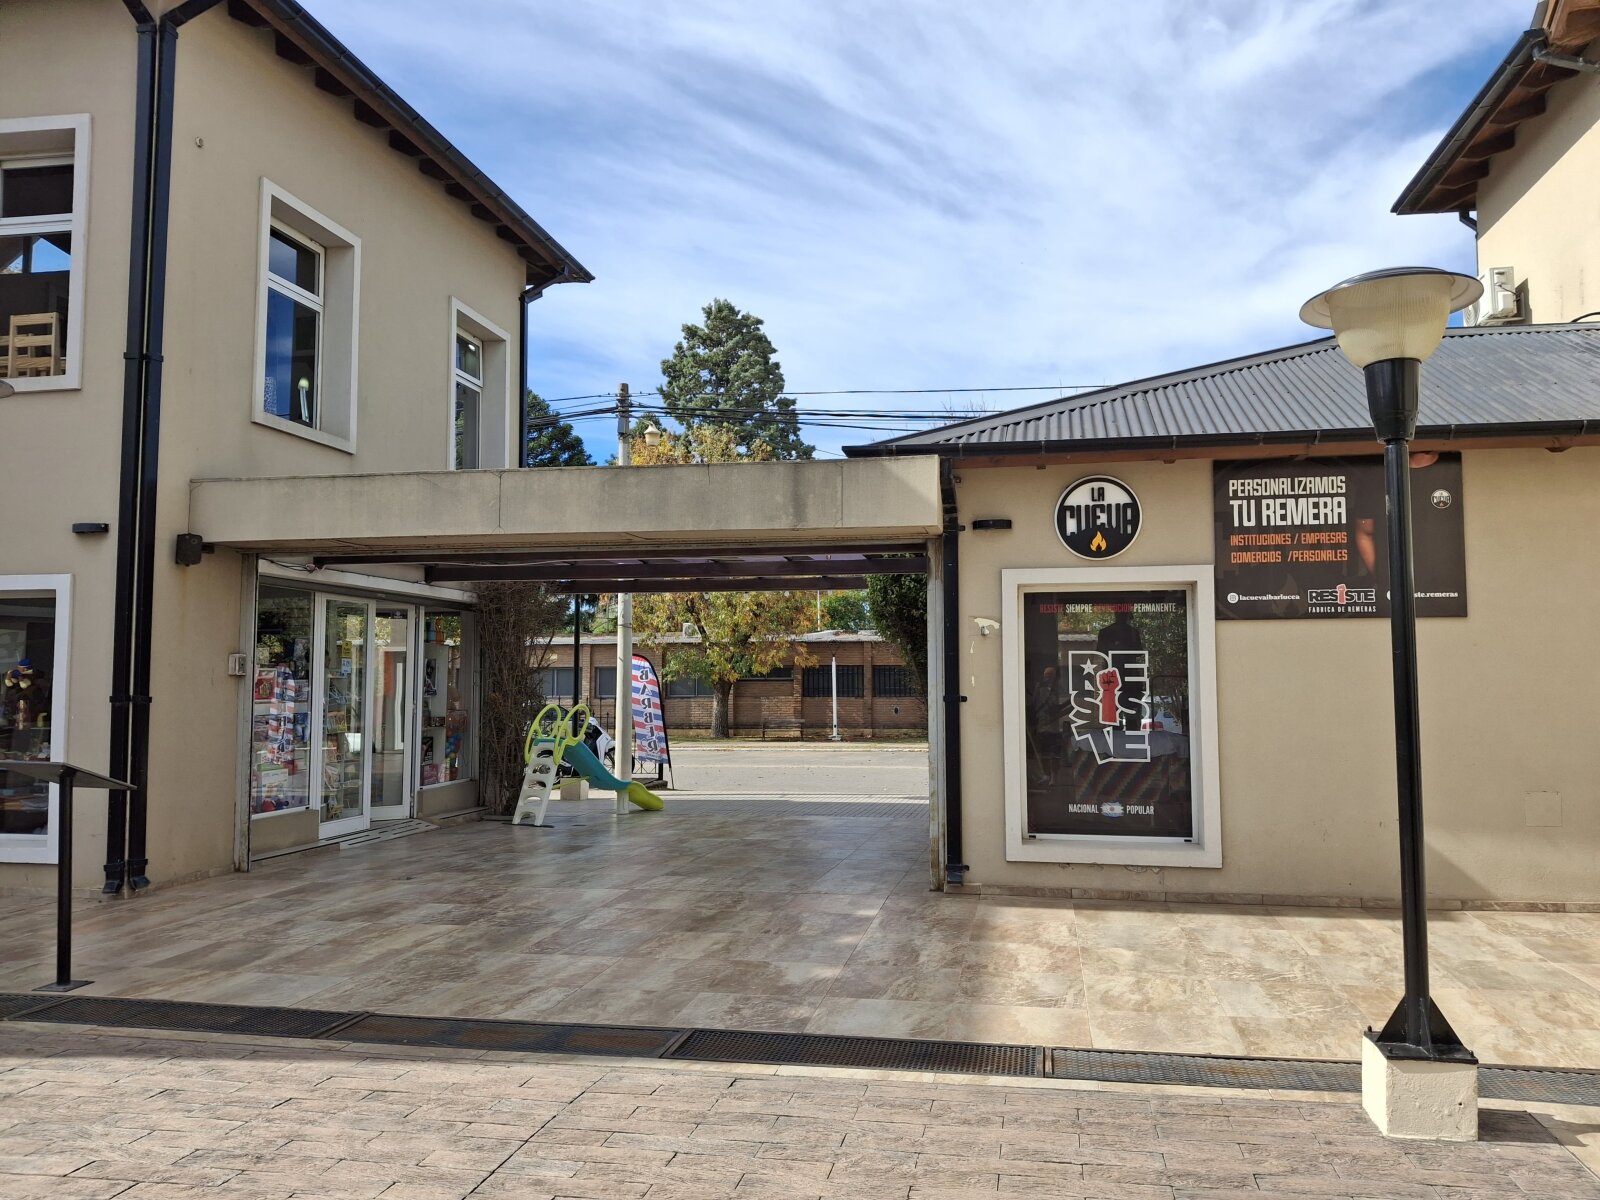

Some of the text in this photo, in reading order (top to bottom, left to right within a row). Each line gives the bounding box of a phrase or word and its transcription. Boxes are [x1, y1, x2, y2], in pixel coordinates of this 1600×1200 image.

[1229, 476, 1346, 497] PERSONALIZAMOS
[1091, 487, 1104, 501] LA
[1230, 496, 1347, 527] TU REMERA
[1063, 502, 1136, 536] CUEVA
[1230, 533, 1291, 546] INSTITUCIONES
[1301, 532, 1347, 544] EMPRESAS
[1231, 551, 1282, 564] COMERCIOS
[1065, 603, 1093, 613] SIEMPRE
[1133, 603, 1176, 613] PERMANENTE
[1068, 803, 1155, 815] NACIONAL POPULAR
